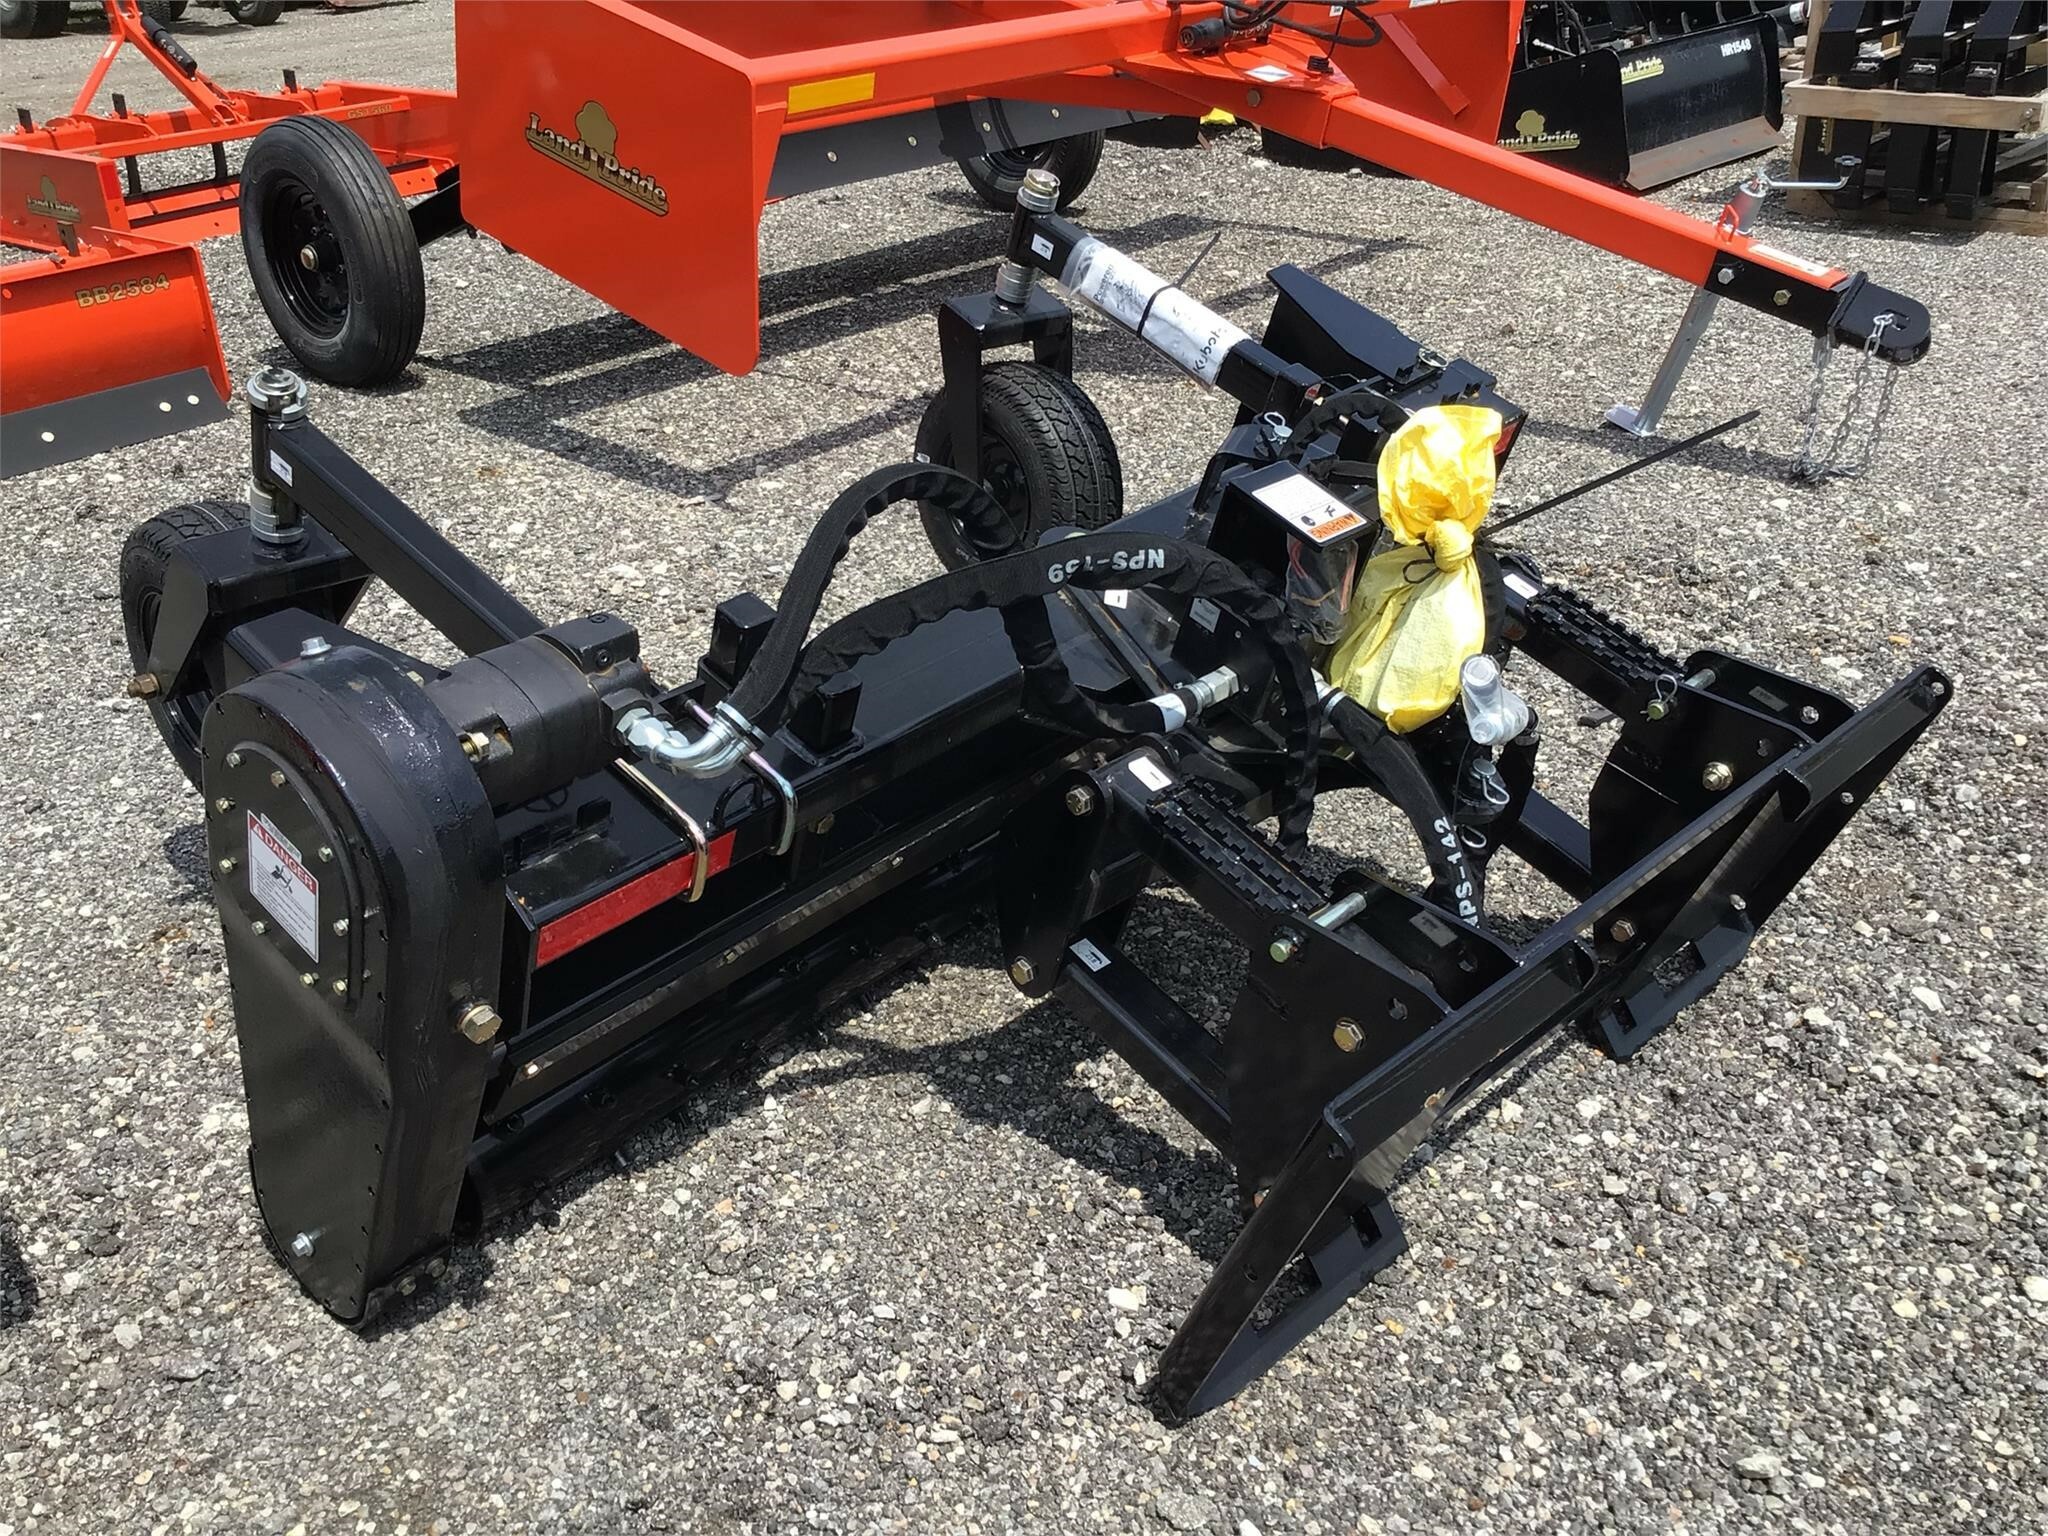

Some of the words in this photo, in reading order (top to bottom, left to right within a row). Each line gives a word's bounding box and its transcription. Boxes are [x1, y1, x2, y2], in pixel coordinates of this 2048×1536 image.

[1720, 38, 1752, 57] HR1548
[1635, 56, 1663, 76] Pride
[1538, 130, 1579, 148] Pride
[526, 113, 589, 164] Land
[599, 152, 668, 207] Pride
[75, 272, 171, 308] BB2584
[263, 833, 314, 891] DANGER
